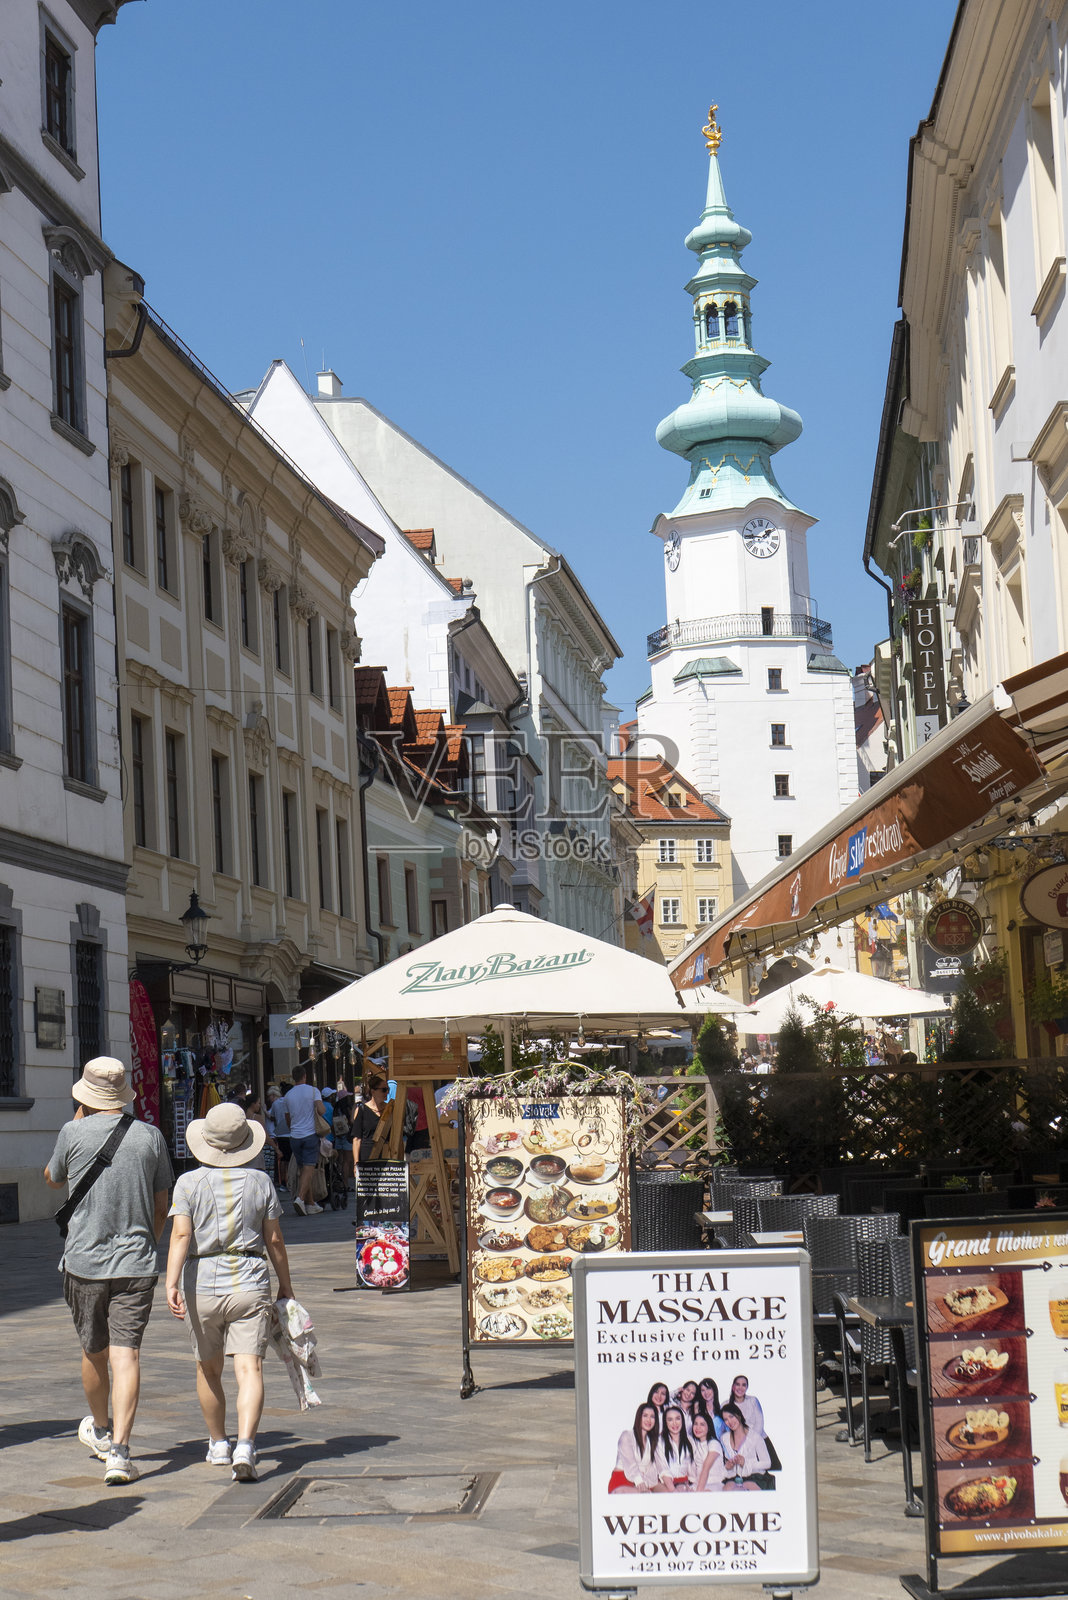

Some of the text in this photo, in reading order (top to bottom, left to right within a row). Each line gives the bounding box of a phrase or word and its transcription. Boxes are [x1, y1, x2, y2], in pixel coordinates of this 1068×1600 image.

[916, 608, 939, 710] HOTEL
[398, 949, 592, 995] Zlatý Bažant
[525, 1104, 556, 1118] slovak
[928, 1231, 991, 1266] Grand
[996, 1230, 1050, 1254] Mother's
[652, 1271, 731, 1293] THAI
[596, 1295, 788, 1325] MASSAGE
[597, 1329, 687, 1345] Exclusive
[693, 1327, 725, 1343] full
[744, 1326, 787, 1344] body
[597, 1344, 788, 1366] massage from 25€
[603, 1511, 783, 1536] WELCOME
[619, 1539, 769, 1559] NOW OPEN
[630, 1559, 758, 1573] +421 907 502 638
